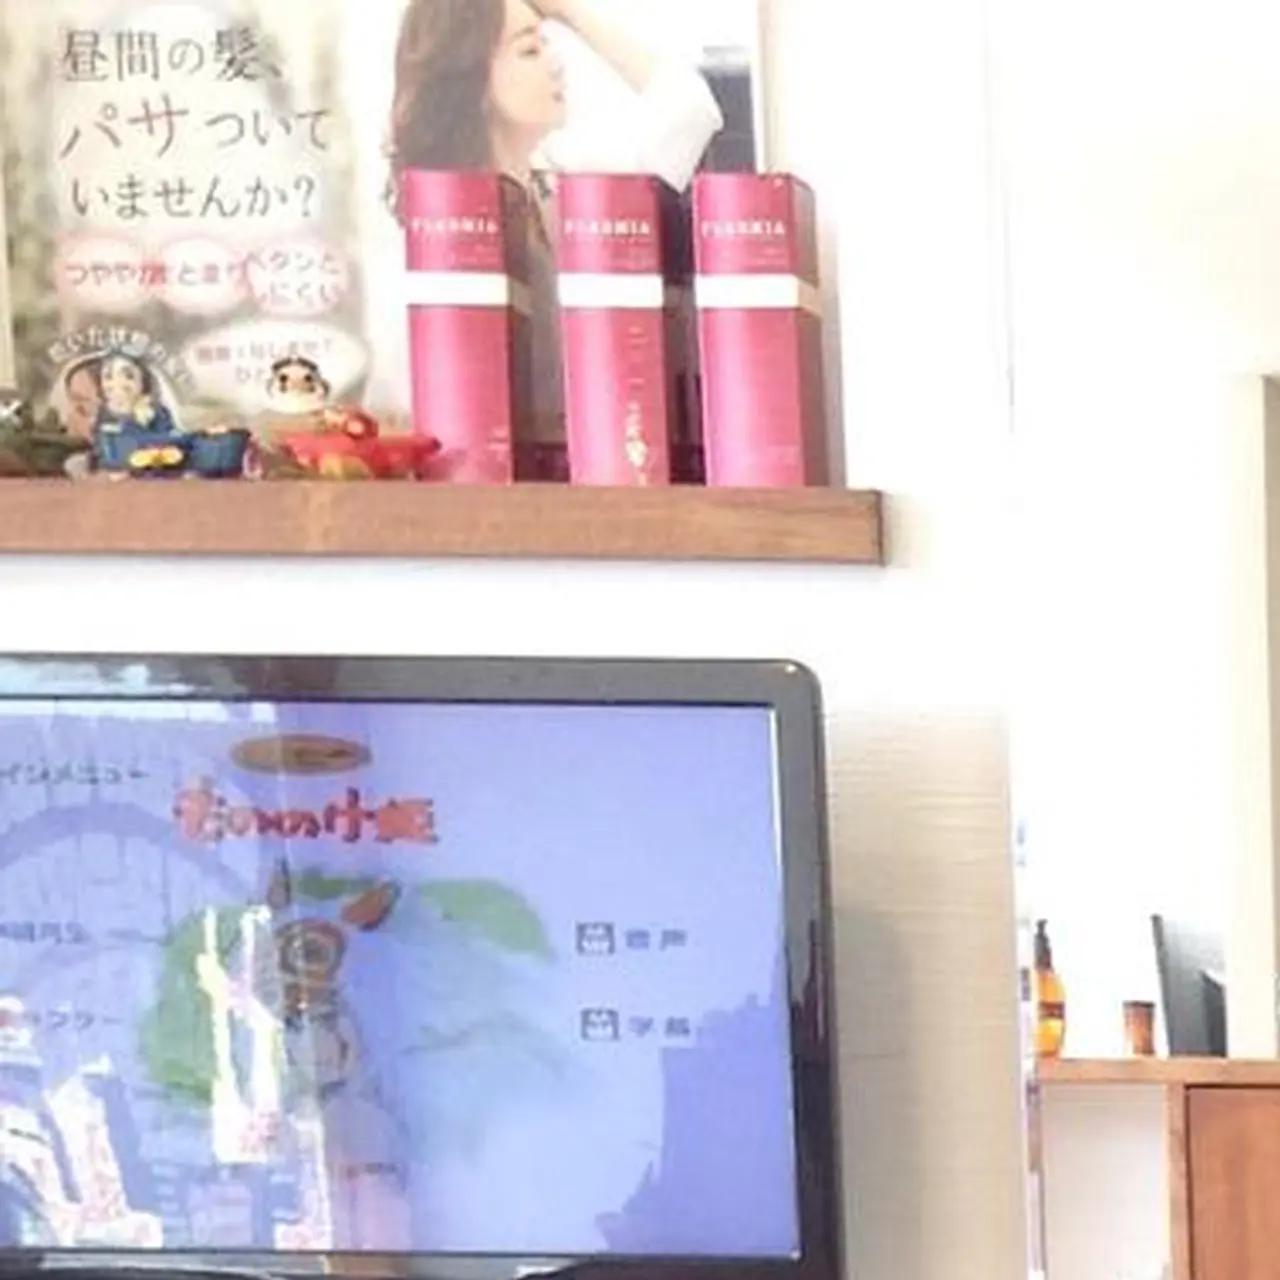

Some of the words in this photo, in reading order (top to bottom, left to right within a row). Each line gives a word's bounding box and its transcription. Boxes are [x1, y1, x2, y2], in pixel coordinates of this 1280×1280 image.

[62, 27, 282, 82] 昼間の髪、
[59, 92, 332, 159] パサついて
